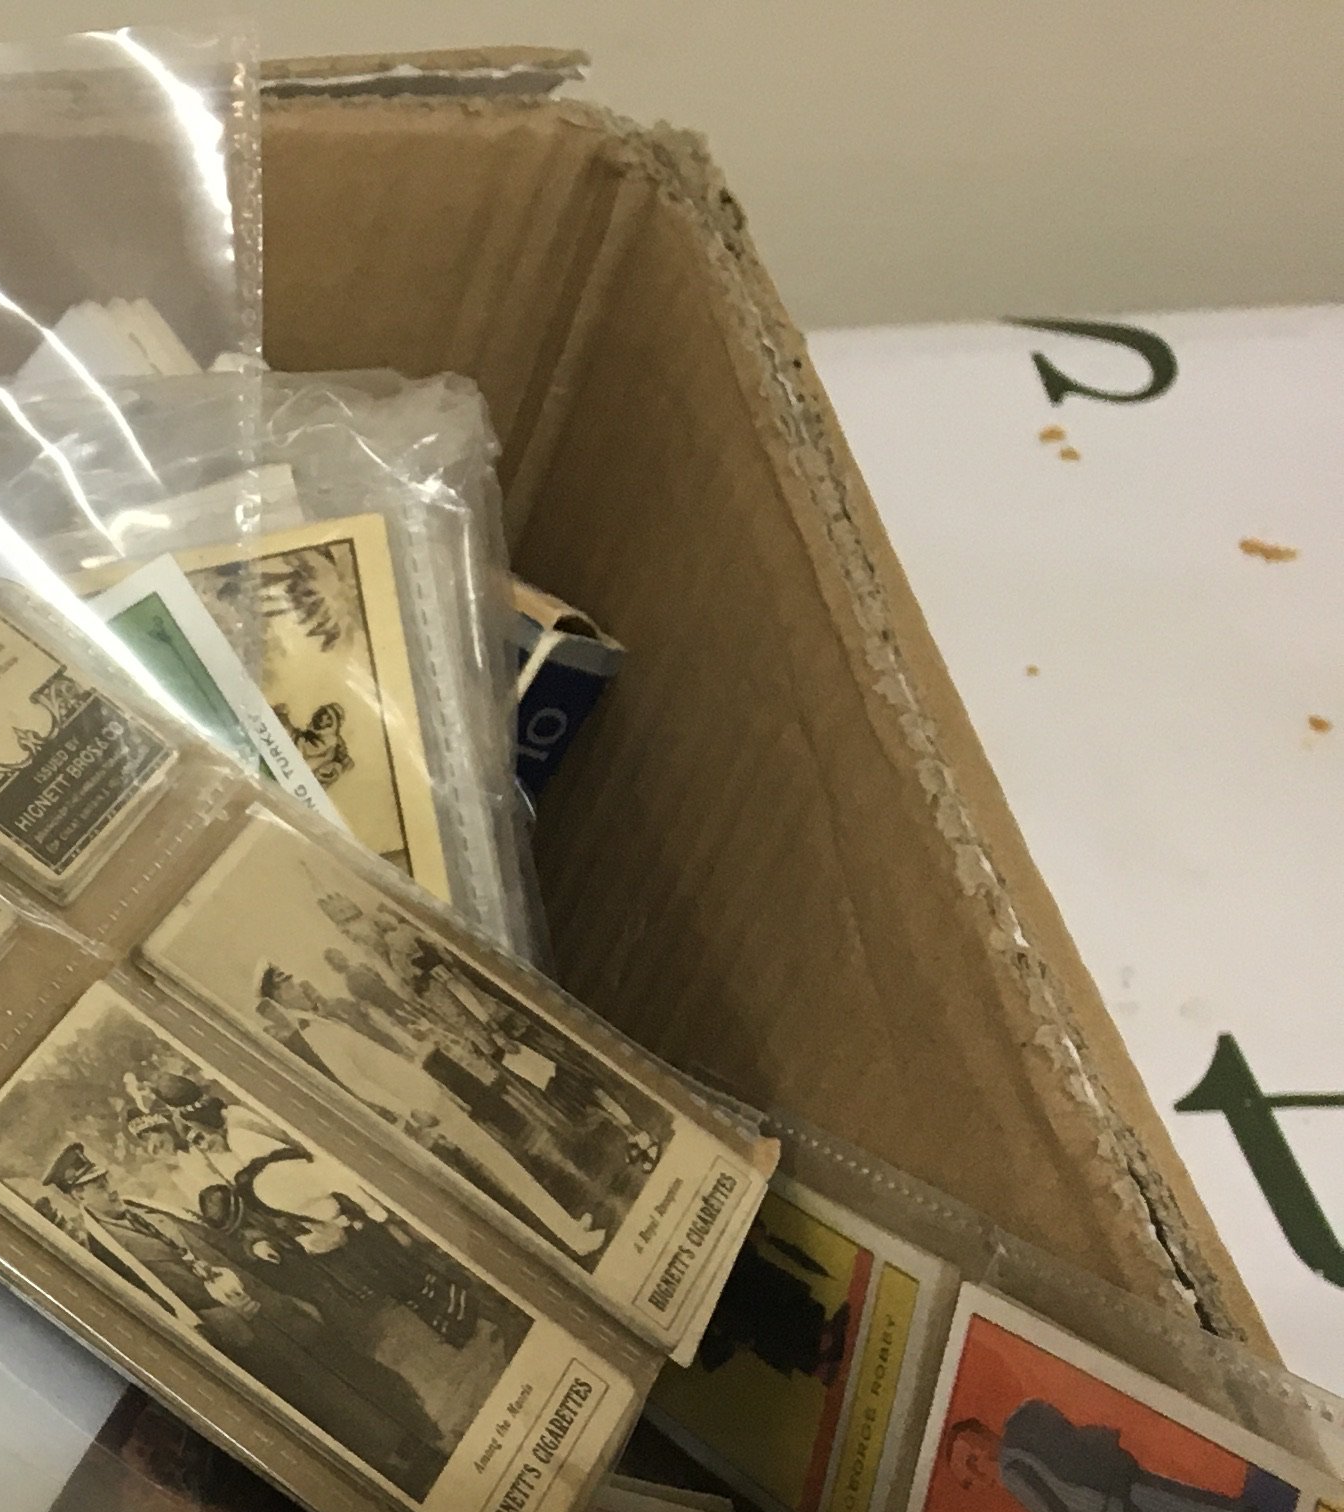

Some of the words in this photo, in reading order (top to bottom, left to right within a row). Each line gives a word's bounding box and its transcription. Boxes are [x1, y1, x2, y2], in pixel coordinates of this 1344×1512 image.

[15, 774, 71, 832] HIGNETT
[33, 750, 69, 784] ISSUED
[648, 1245, 695, 1312] HIGNETT'S
[686, 1172, 737, 1247] CIGARETTES
[473, 1438, 502, 1475] Among
[496, 1419, 510, 1437] the
[532, 1377, 593, 1464] CIGARETTES
[847, 1406, 876, 1510] GEORGE
[871, 1313, 896, 1396] ROBEY
